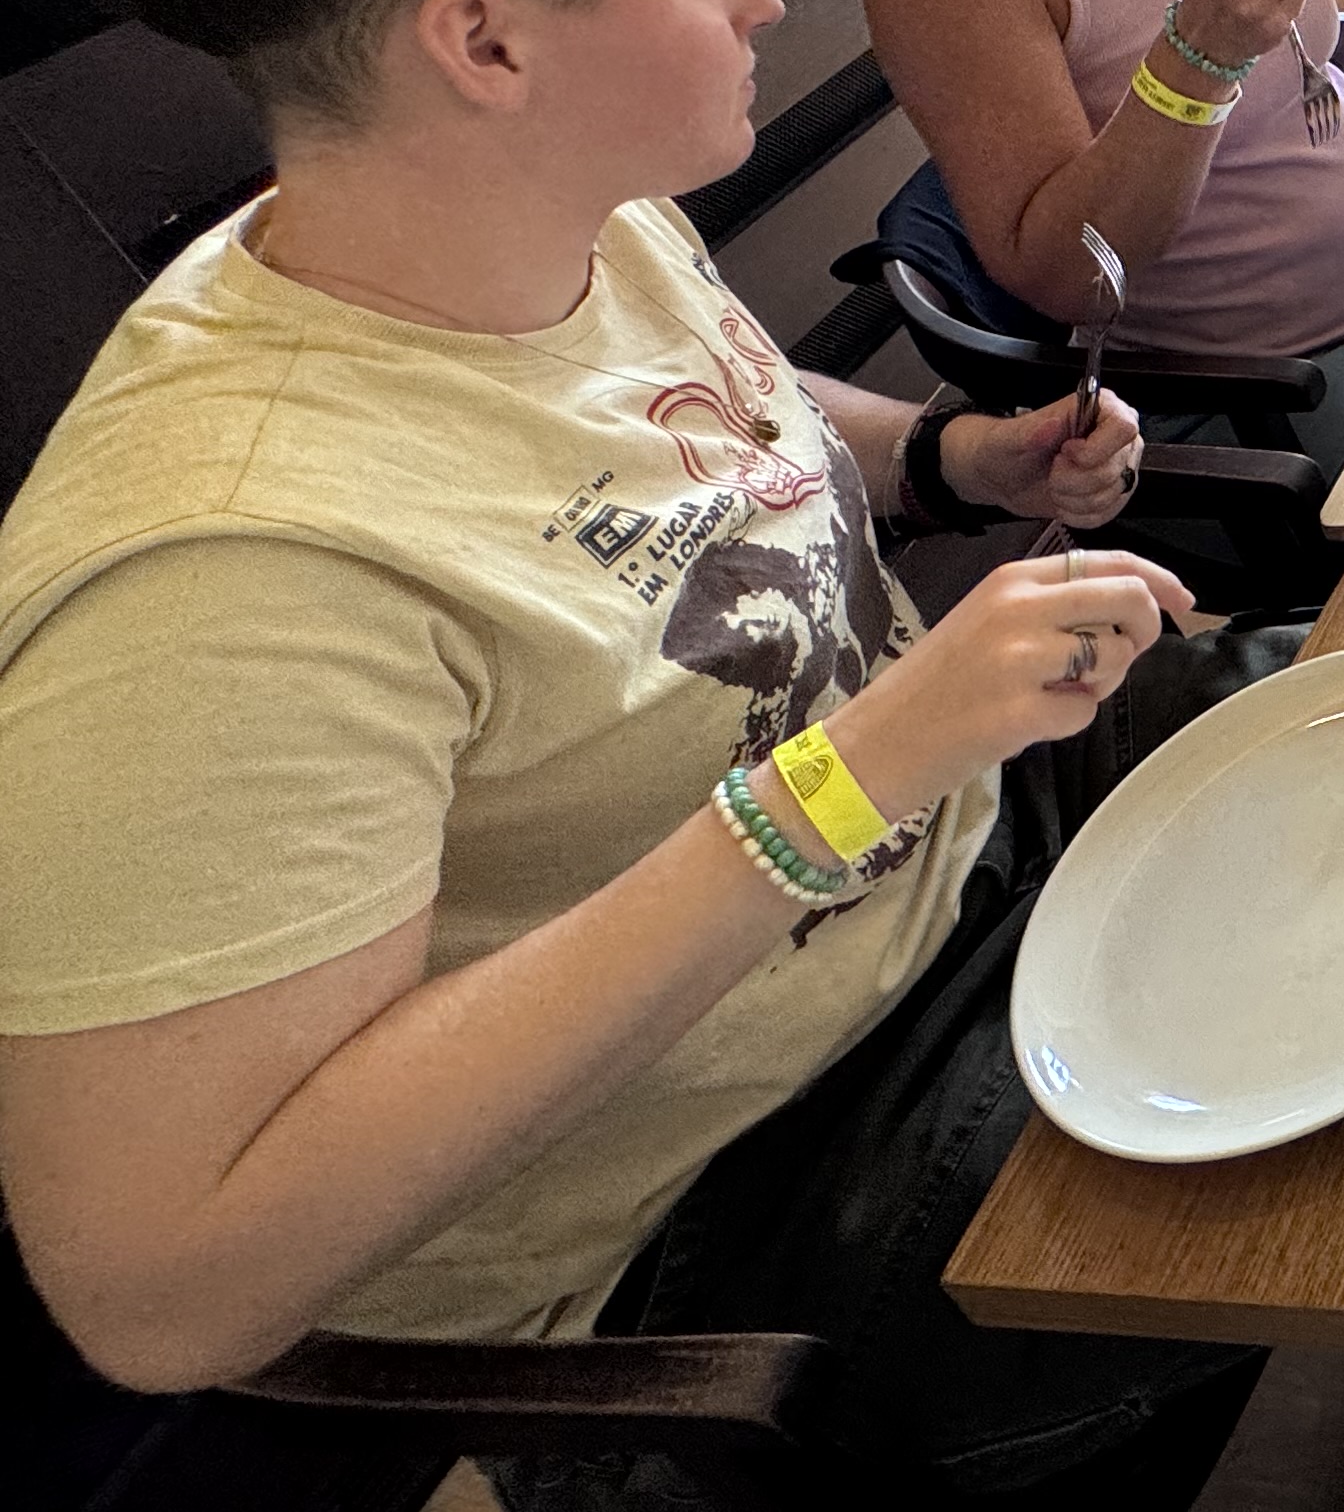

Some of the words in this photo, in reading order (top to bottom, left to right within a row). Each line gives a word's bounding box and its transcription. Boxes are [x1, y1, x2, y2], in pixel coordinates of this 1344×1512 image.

[637, 573, 669, 607] EM
[670, 491, 736, 571] LONDRES
[647, 501, 703, 562] LUGAR
